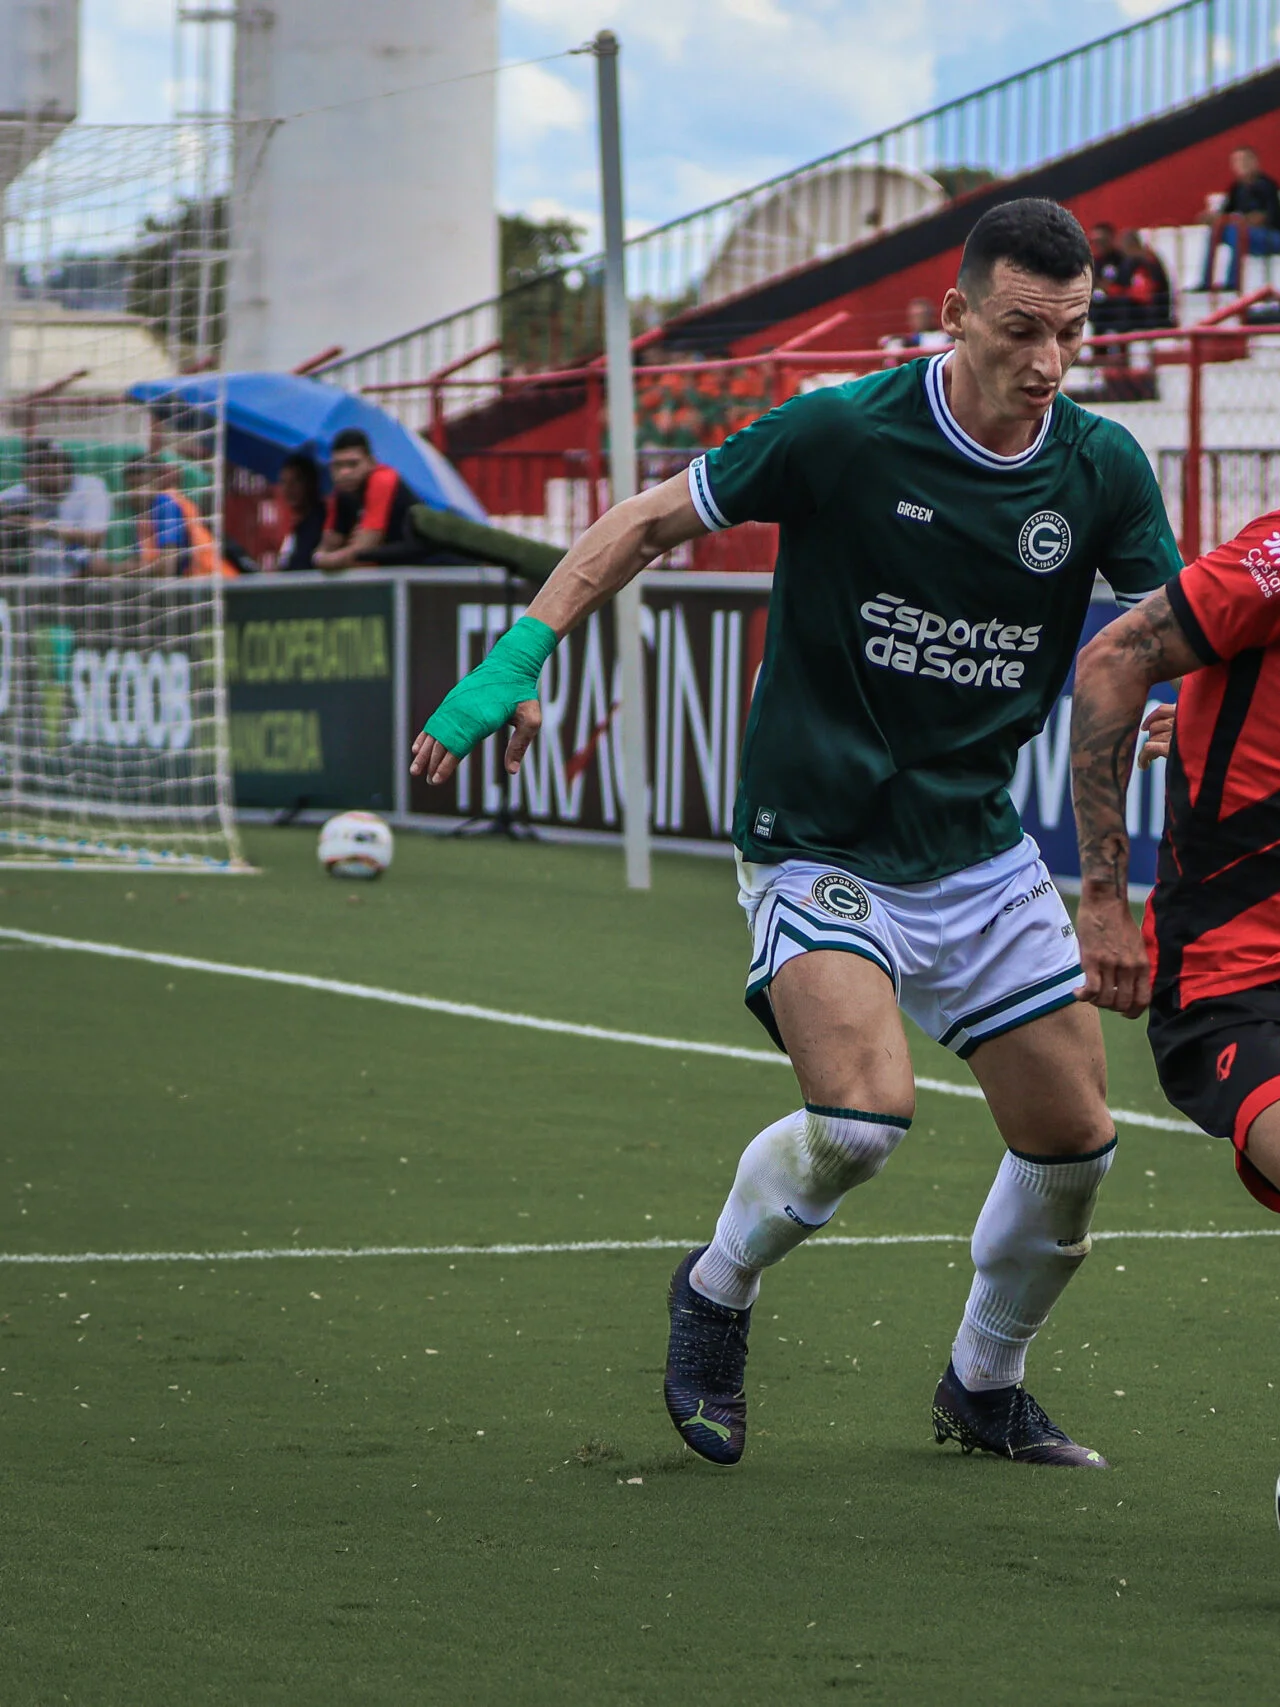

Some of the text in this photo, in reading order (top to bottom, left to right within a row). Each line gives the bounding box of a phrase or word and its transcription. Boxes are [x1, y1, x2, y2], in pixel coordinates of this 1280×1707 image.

[897, 501, 933, 523] GREEN
[1030, 514, 1063, 528] ESPORTE
[1028, 521, 1061, 561] G
[860, 592, 1043, 652] Esportes
[69, 649, 192, 751] SICOOB
